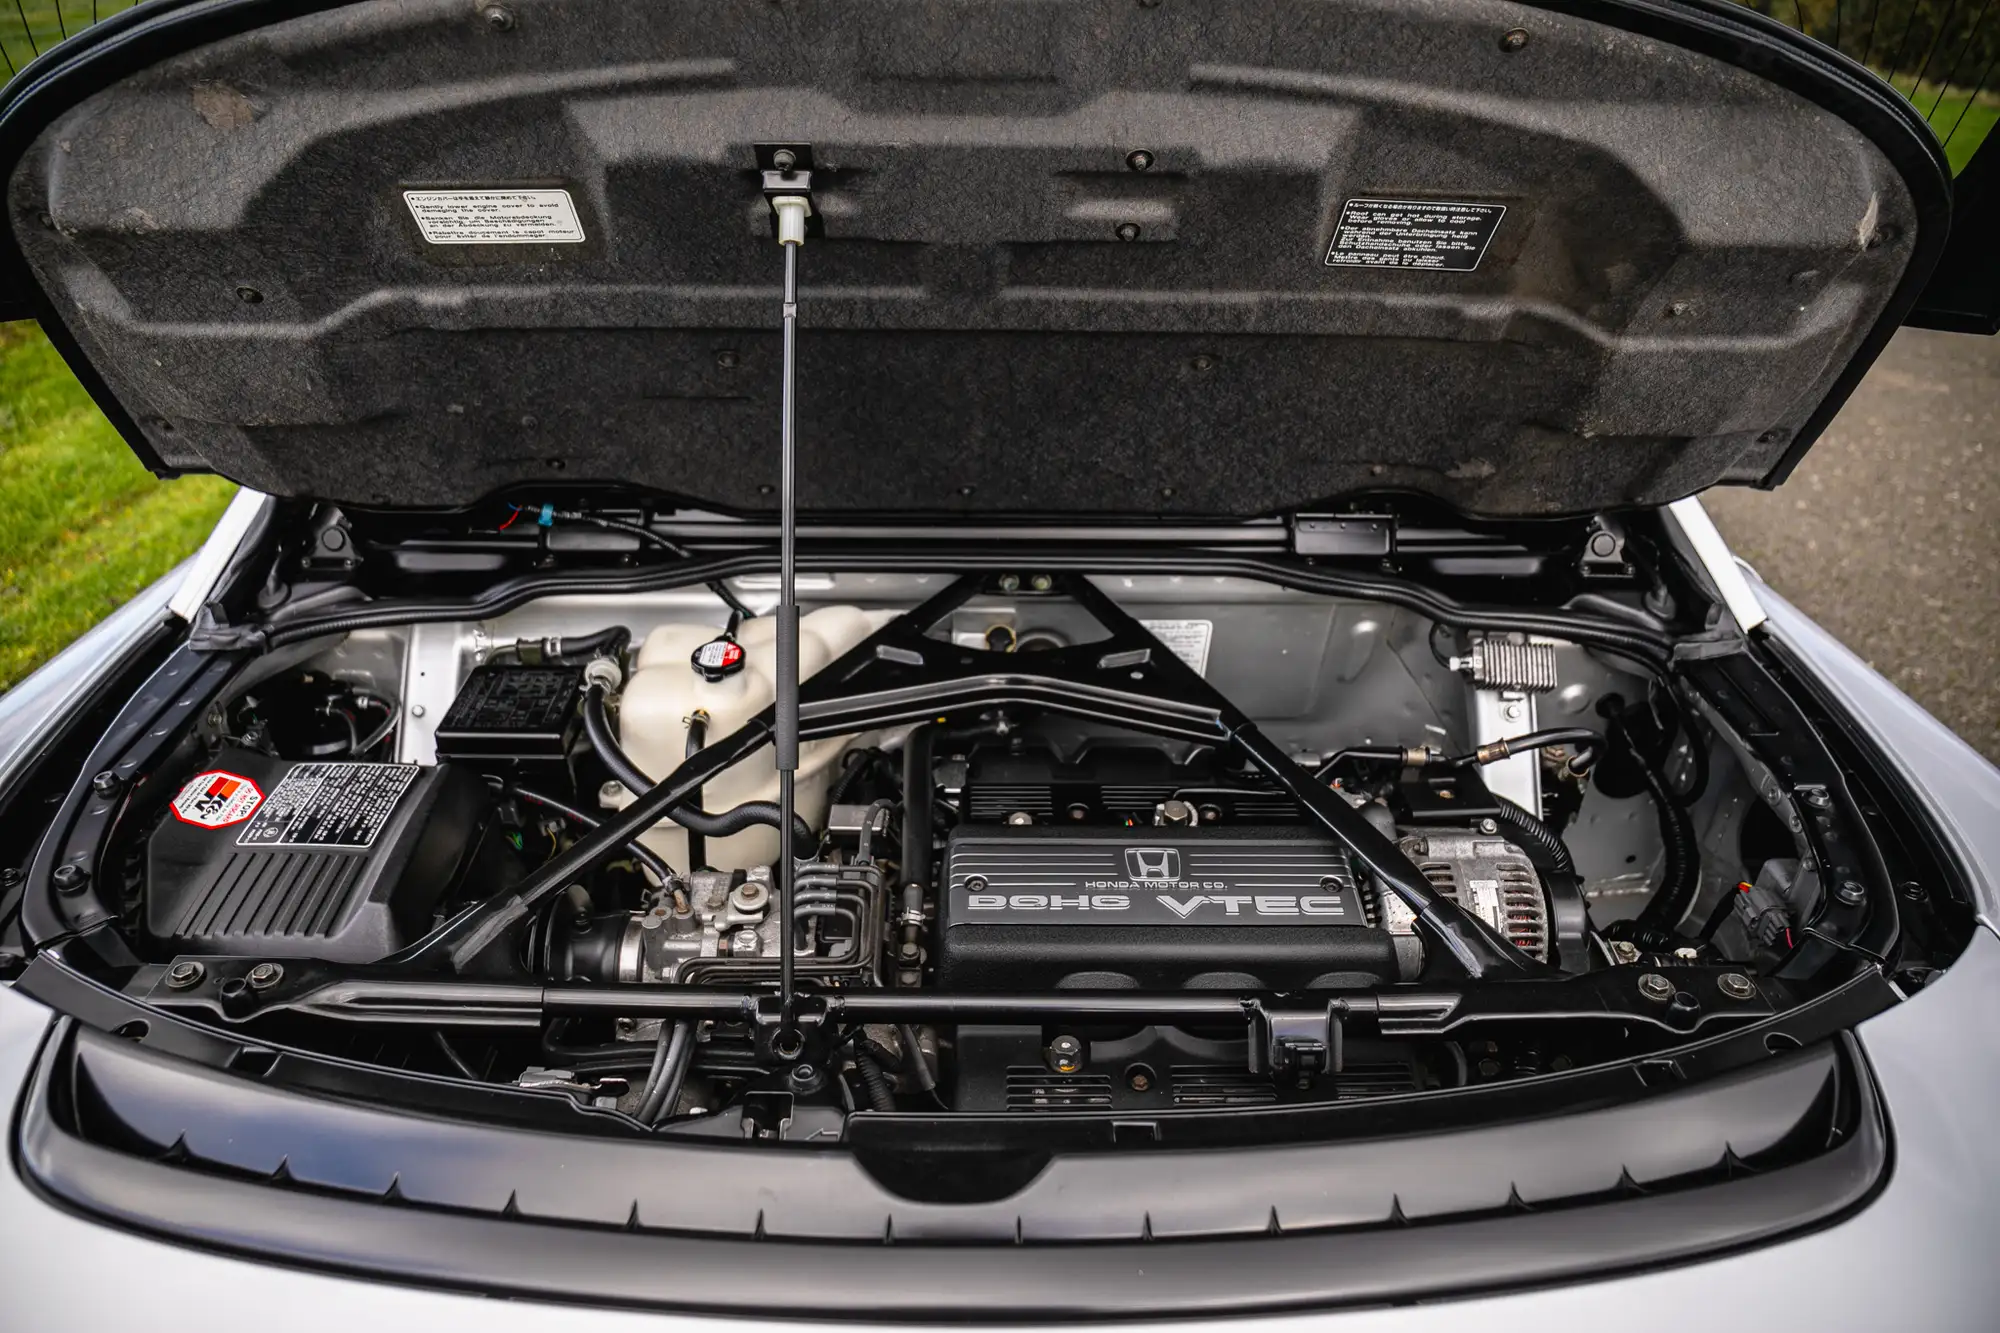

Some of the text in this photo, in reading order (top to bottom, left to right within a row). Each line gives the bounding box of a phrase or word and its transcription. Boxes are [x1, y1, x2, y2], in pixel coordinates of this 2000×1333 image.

[1144, 881, 1200, 889] MOTOR
[967, 895, 1345, 919] DOHC VTEC
